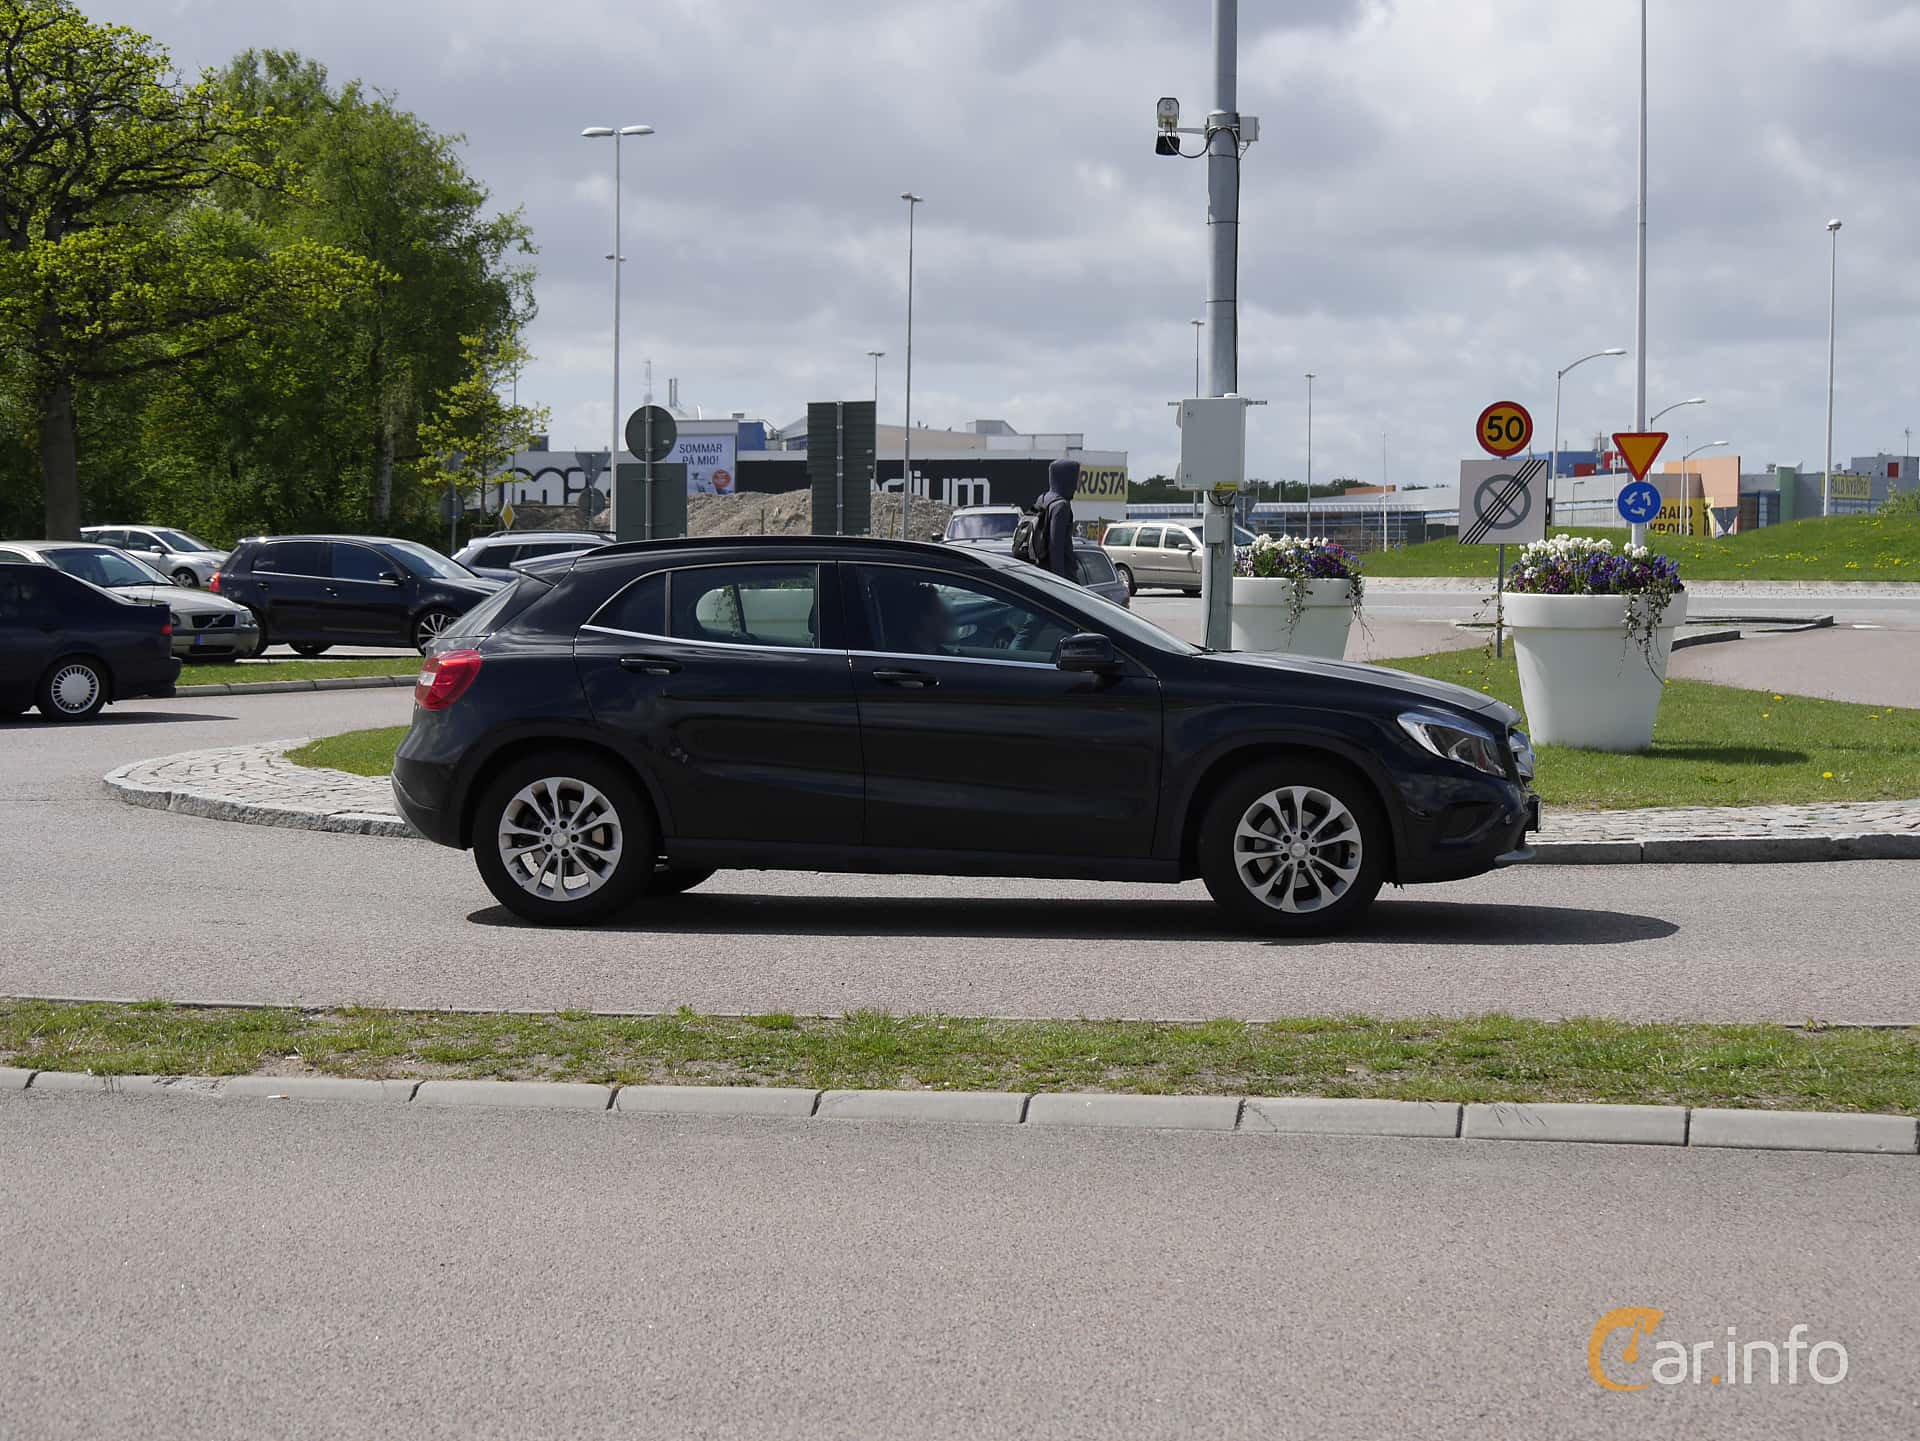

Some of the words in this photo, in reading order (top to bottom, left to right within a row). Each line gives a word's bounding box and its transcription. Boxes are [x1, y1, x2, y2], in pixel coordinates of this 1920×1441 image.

[1487, 416, 1524, 442] 50
[679, 443, 722, 453] SOMMAR
[682, 454, 694, 465] PÅ
[697, 455, 719, 465] MIO!
[1077, 471, 1125, 495] RUSTA
[1655, 506, 1693, 519] RALD
